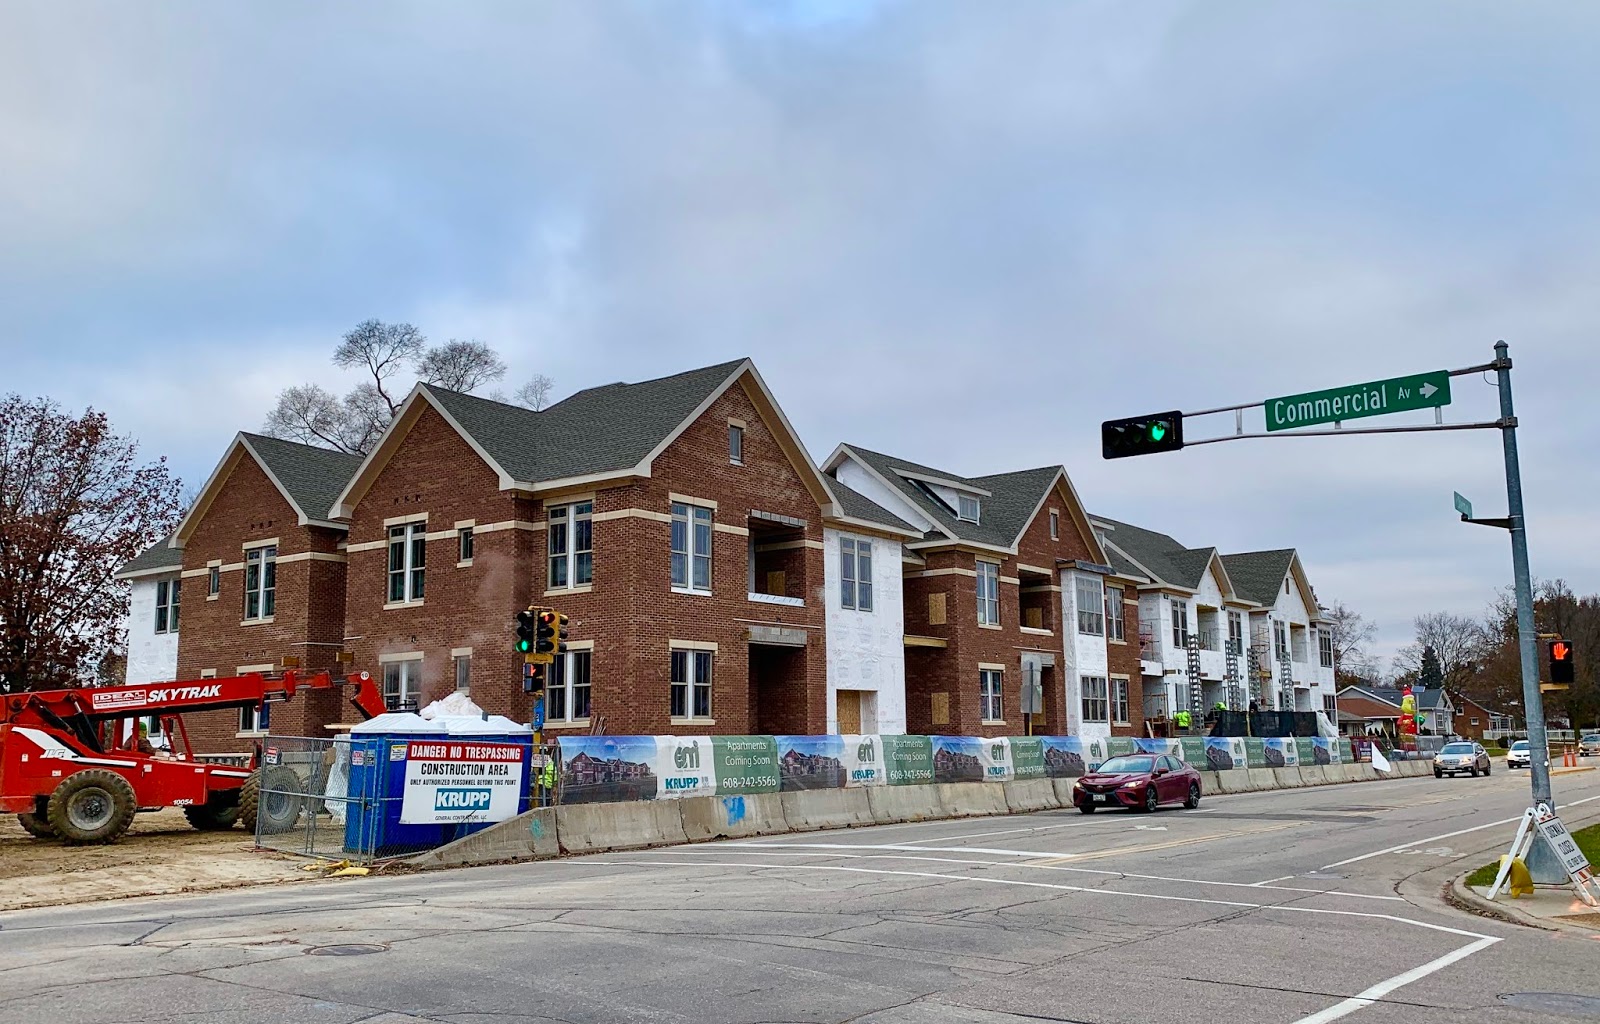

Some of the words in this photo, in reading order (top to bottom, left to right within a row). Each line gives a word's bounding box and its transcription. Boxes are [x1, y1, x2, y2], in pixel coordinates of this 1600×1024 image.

[1274, 383, 1387, 425] Commercial
[1397, 386, 1411, 400] Av
[94, 691, 145, 701] IDEAL
[147, 684, 222, 703] SKYTRAK
[727, 741, 767, 752] Apartments
[892, 740, 924, 749] Apartments
[411, 745, 447, 758] DANGER
[449, 746, 462, 759] NO
[465, 746, 521, 760] TRESPASSING
[891, 752, 912, 762] Coming
[912, 752, 927, 761] Soon
[725, 756, 752, 767] Coming
[753, 755, 771, 765] Soon
[421, 763, 485, 776] CONSTRUCTION
[488, 764, 509, 776] AREA
[852, 769, 875, 780] KRUPP
[890, 769, 932, 780] 608-242-5566
[410, 778, 421, 786] ONLY
[423, 778, 450, 786] AUTHORIZED
[665, 777, 699, 789] KRUPP
[722, 775, 777, 789] 608-242-5566
[173, 798, 194, 806] 10054
[436, 791, 490, 808] KRUPP
